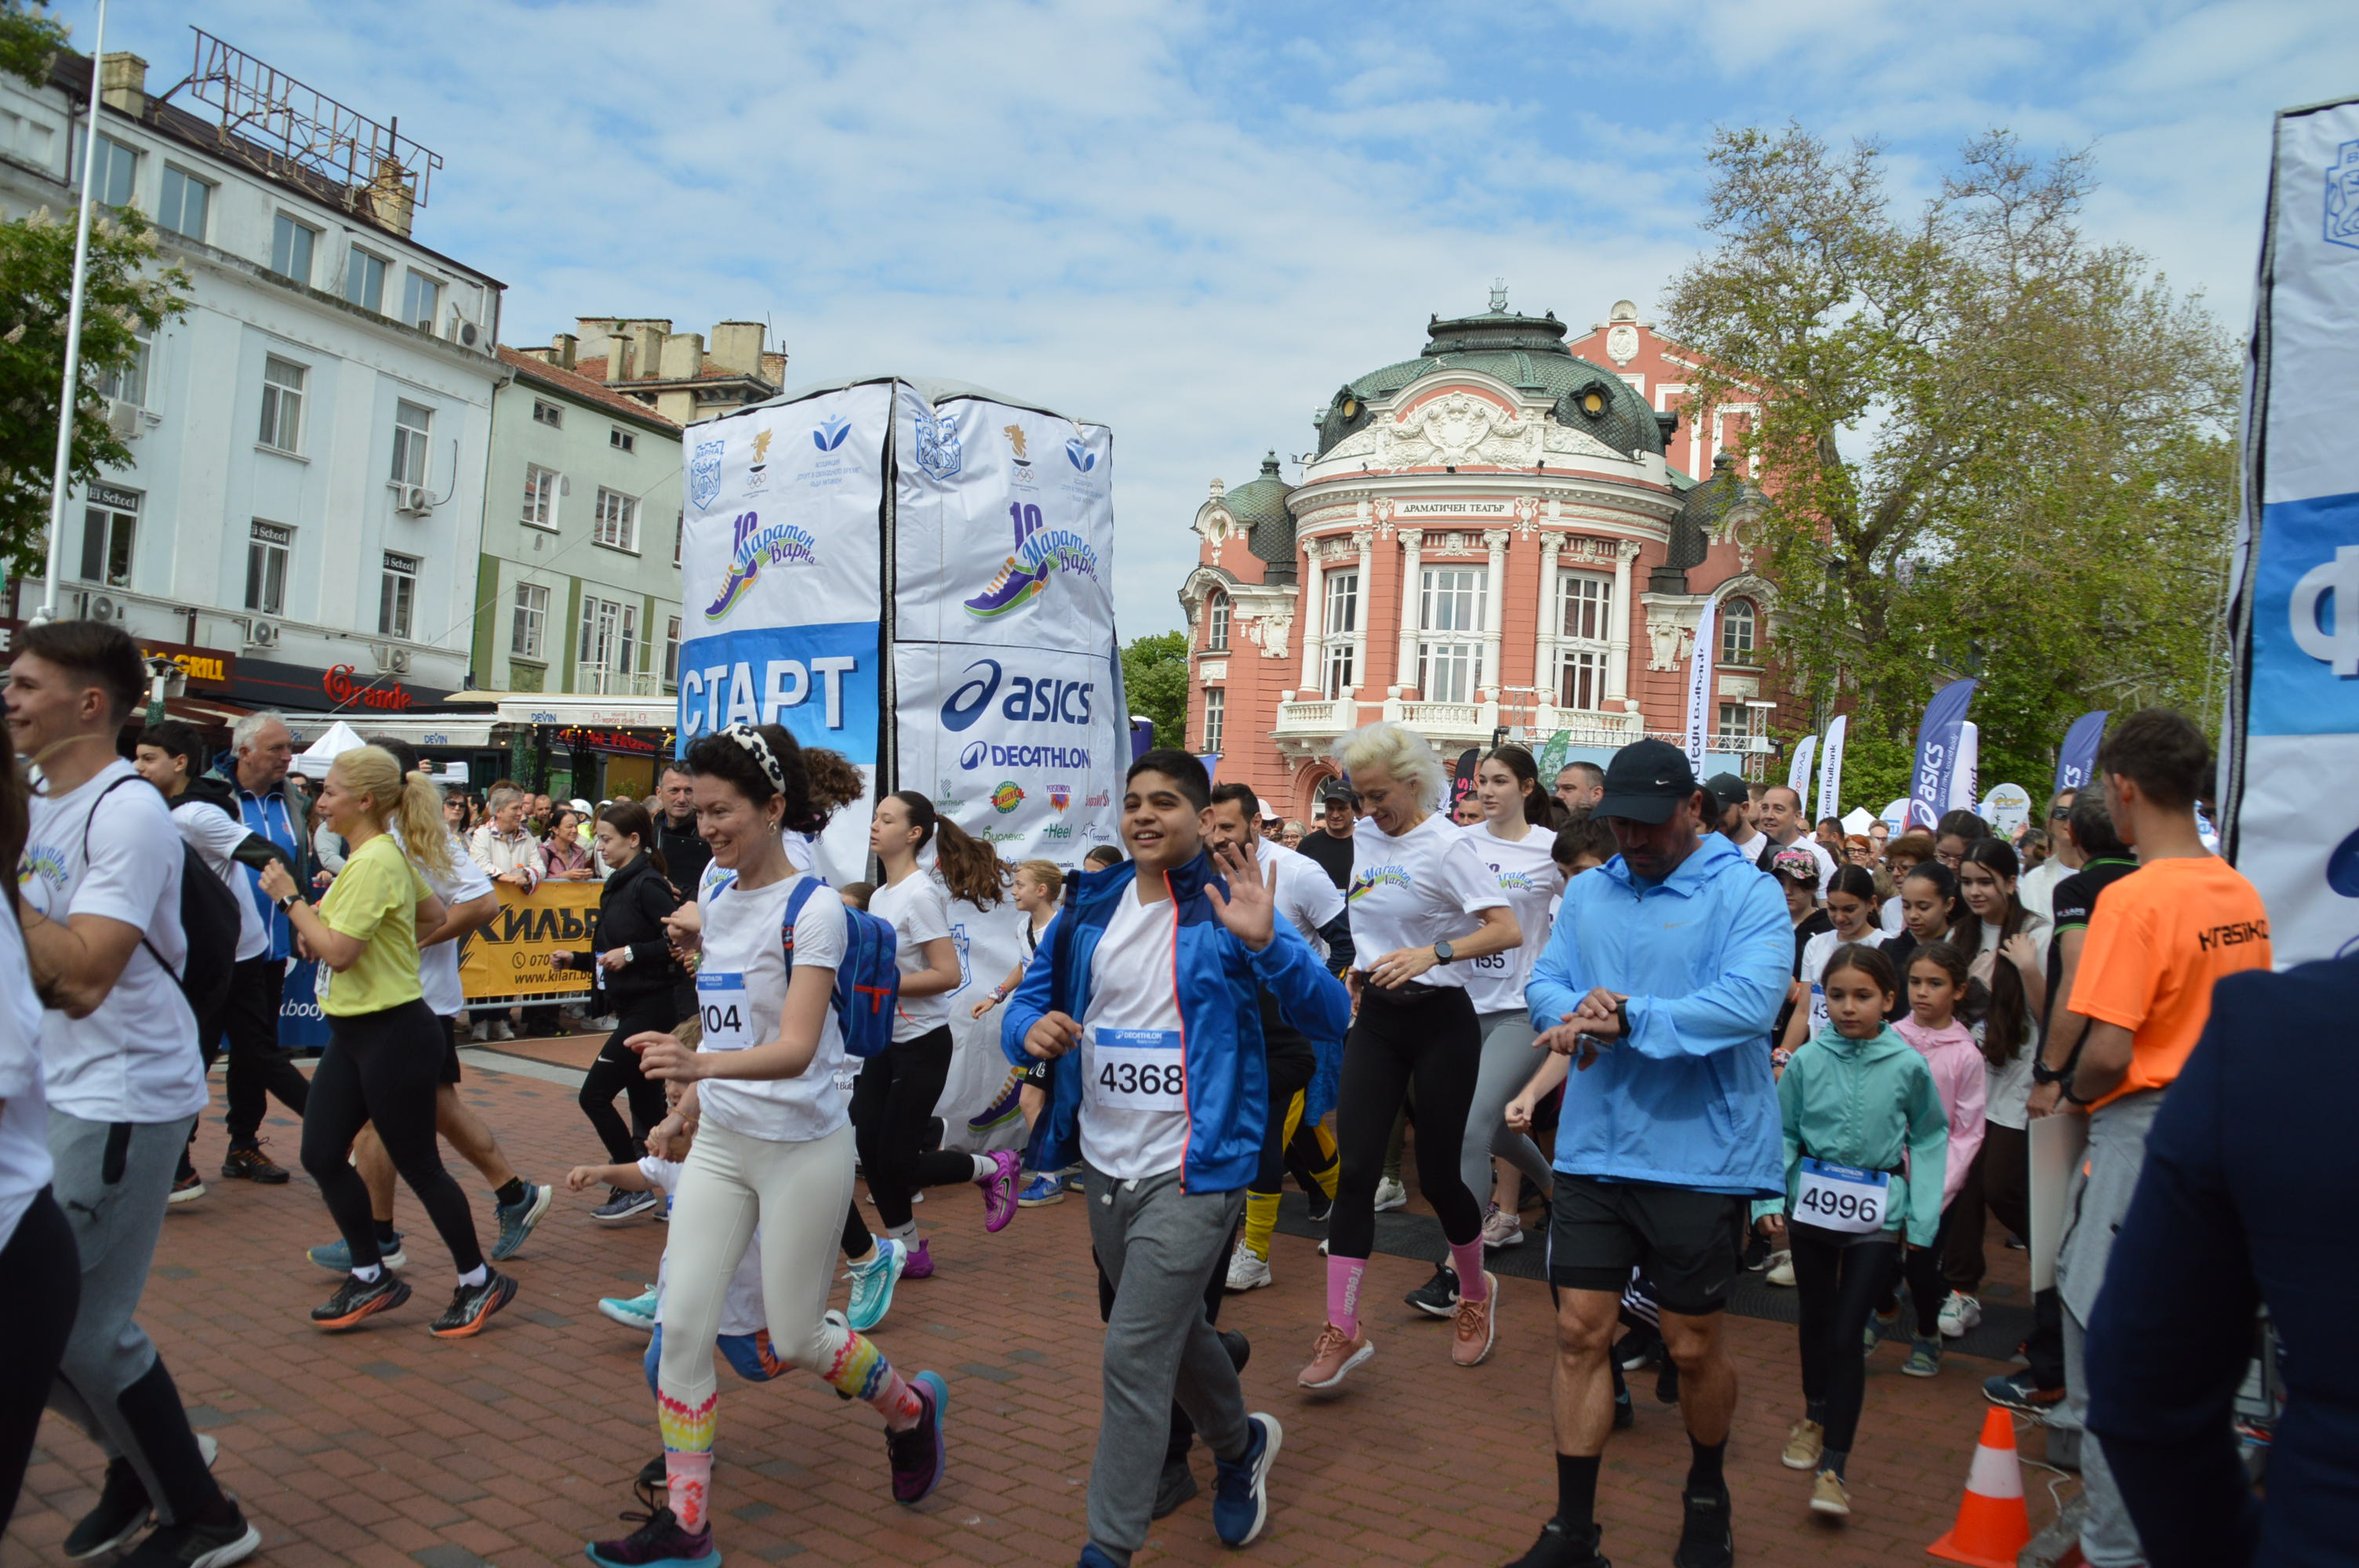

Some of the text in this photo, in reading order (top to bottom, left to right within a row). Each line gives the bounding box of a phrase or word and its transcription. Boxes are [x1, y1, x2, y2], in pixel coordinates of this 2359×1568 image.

[695, 448, 720, 458] ВАРНА
[89, 488, 136, 508] Hi School
[1403, 503, 1505, 513] ДРАМАТИЧЕН ТЕАТЪР
[259, 526, 288, 543] School
[737, 524, 816, 568] Маратон
[768, 541, 816, 564] Варна
[1022, 530, 1098, 572] Маратон
[391, 557, 415, 572] School
[1056, 547, 1098, 582] Варна
[174, 654, 225, 681] GRILL
[323, 664, 413, 710] Grande
[682, 656, 857, 737] СТАРТ
[1002, 677, 1094, 724] asics
[531, 712, 557, 723] DEVIN
[424, 733, 448, 744] DEVIN
[991, 745, 1092, 768] DECATHLON
[1826, 744, 1837, 787] Bulbank
[1945, 750, 1954, 769] sound
[1918, 741, 1944, 802] asics
[1362, 865, 1412, 881] Marathon
[1384, 874, 1410, 891] Varna
[701, 1004, 742, 1033] 104
[1100, 1062, 1183, 1095] 4368
[1802, 1187, 1878, 1223] 4996
